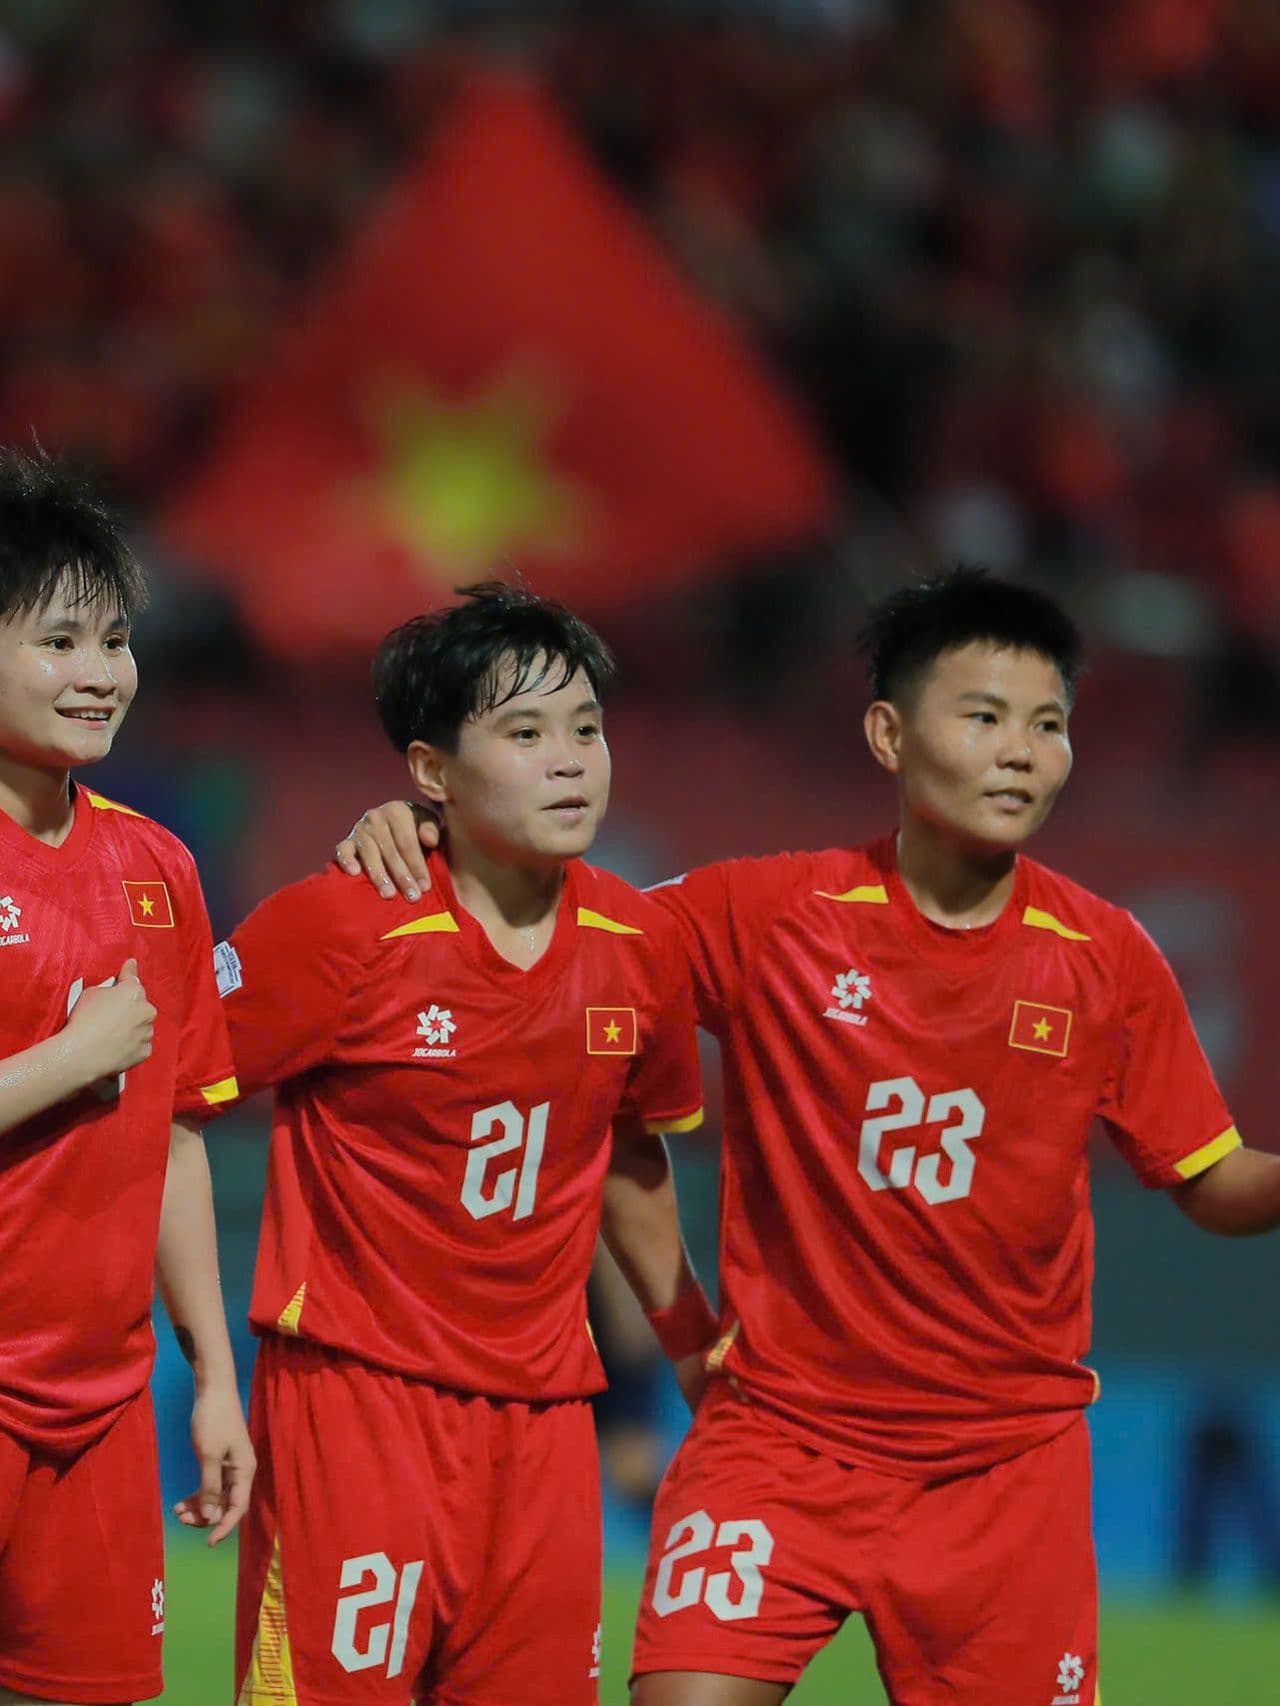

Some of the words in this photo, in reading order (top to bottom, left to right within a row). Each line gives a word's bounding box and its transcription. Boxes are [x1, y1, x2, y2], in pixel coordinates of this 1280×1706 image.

[460, 1100, 550, 1222] 21
[857, 1076, 986, 1206] 23
[331, 1551, 425, 1679] 21
[651, 1509, 775, 1622] 23
